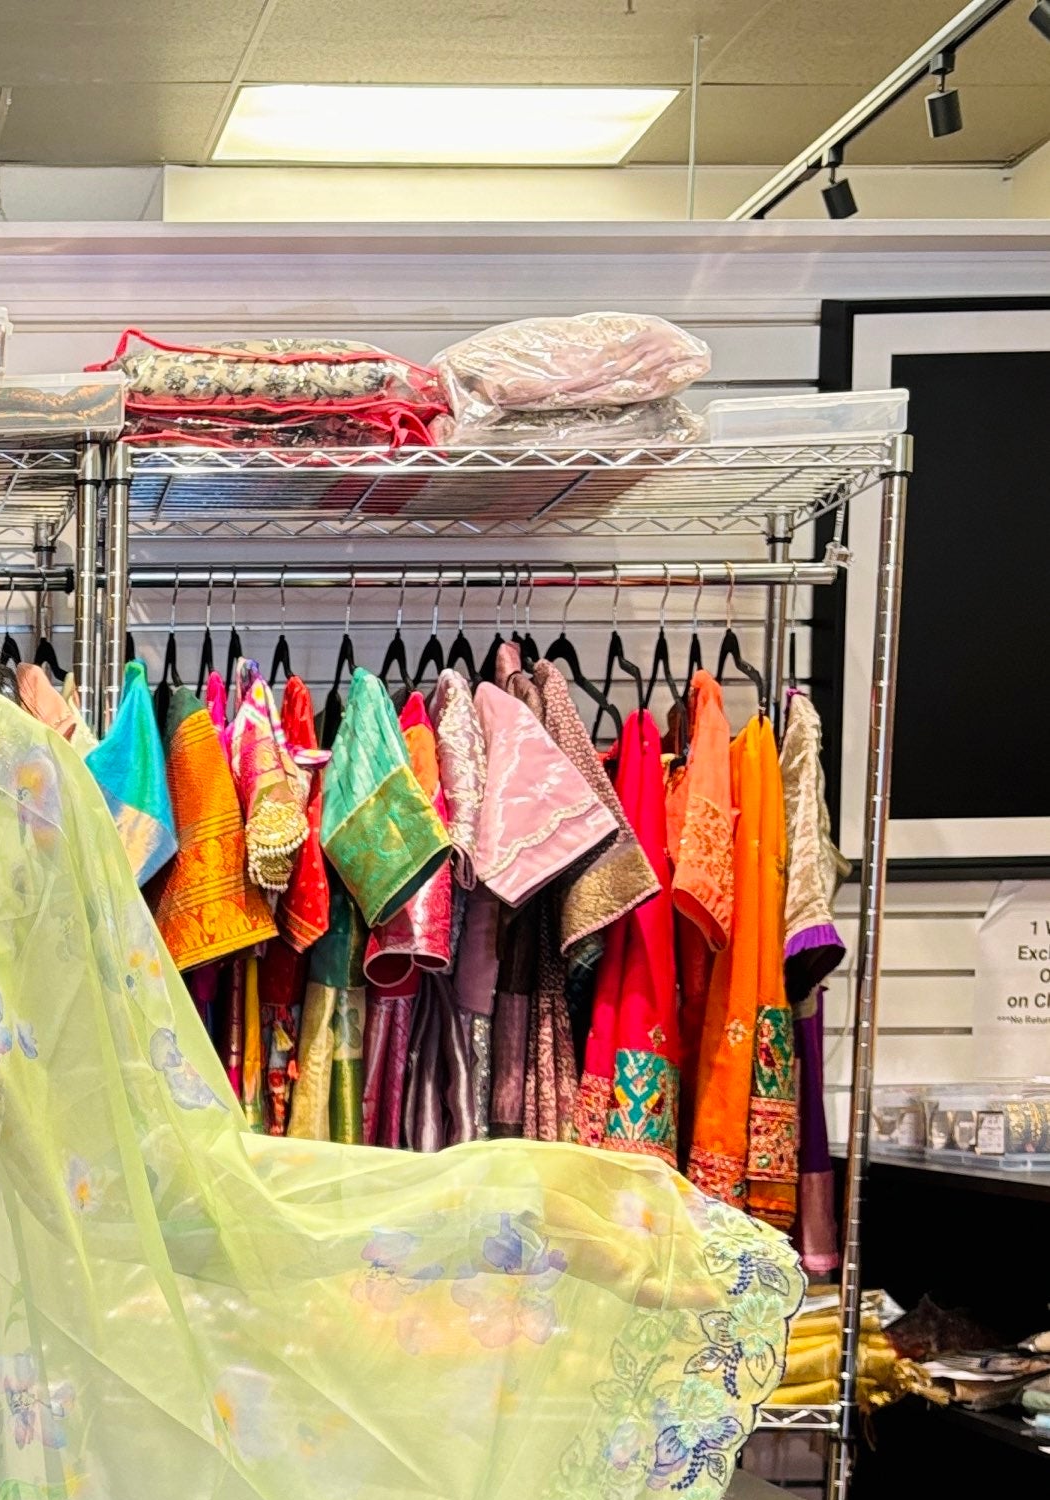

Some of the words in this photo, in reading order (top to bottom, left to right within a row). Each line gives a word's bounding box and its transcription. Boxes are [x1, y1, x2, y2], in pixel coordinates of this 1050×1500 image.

[1030, 920, 1037, 935] 1
[1018, 945, 1050, 960] Exc
[1007, 996, 1029, 1008] on
